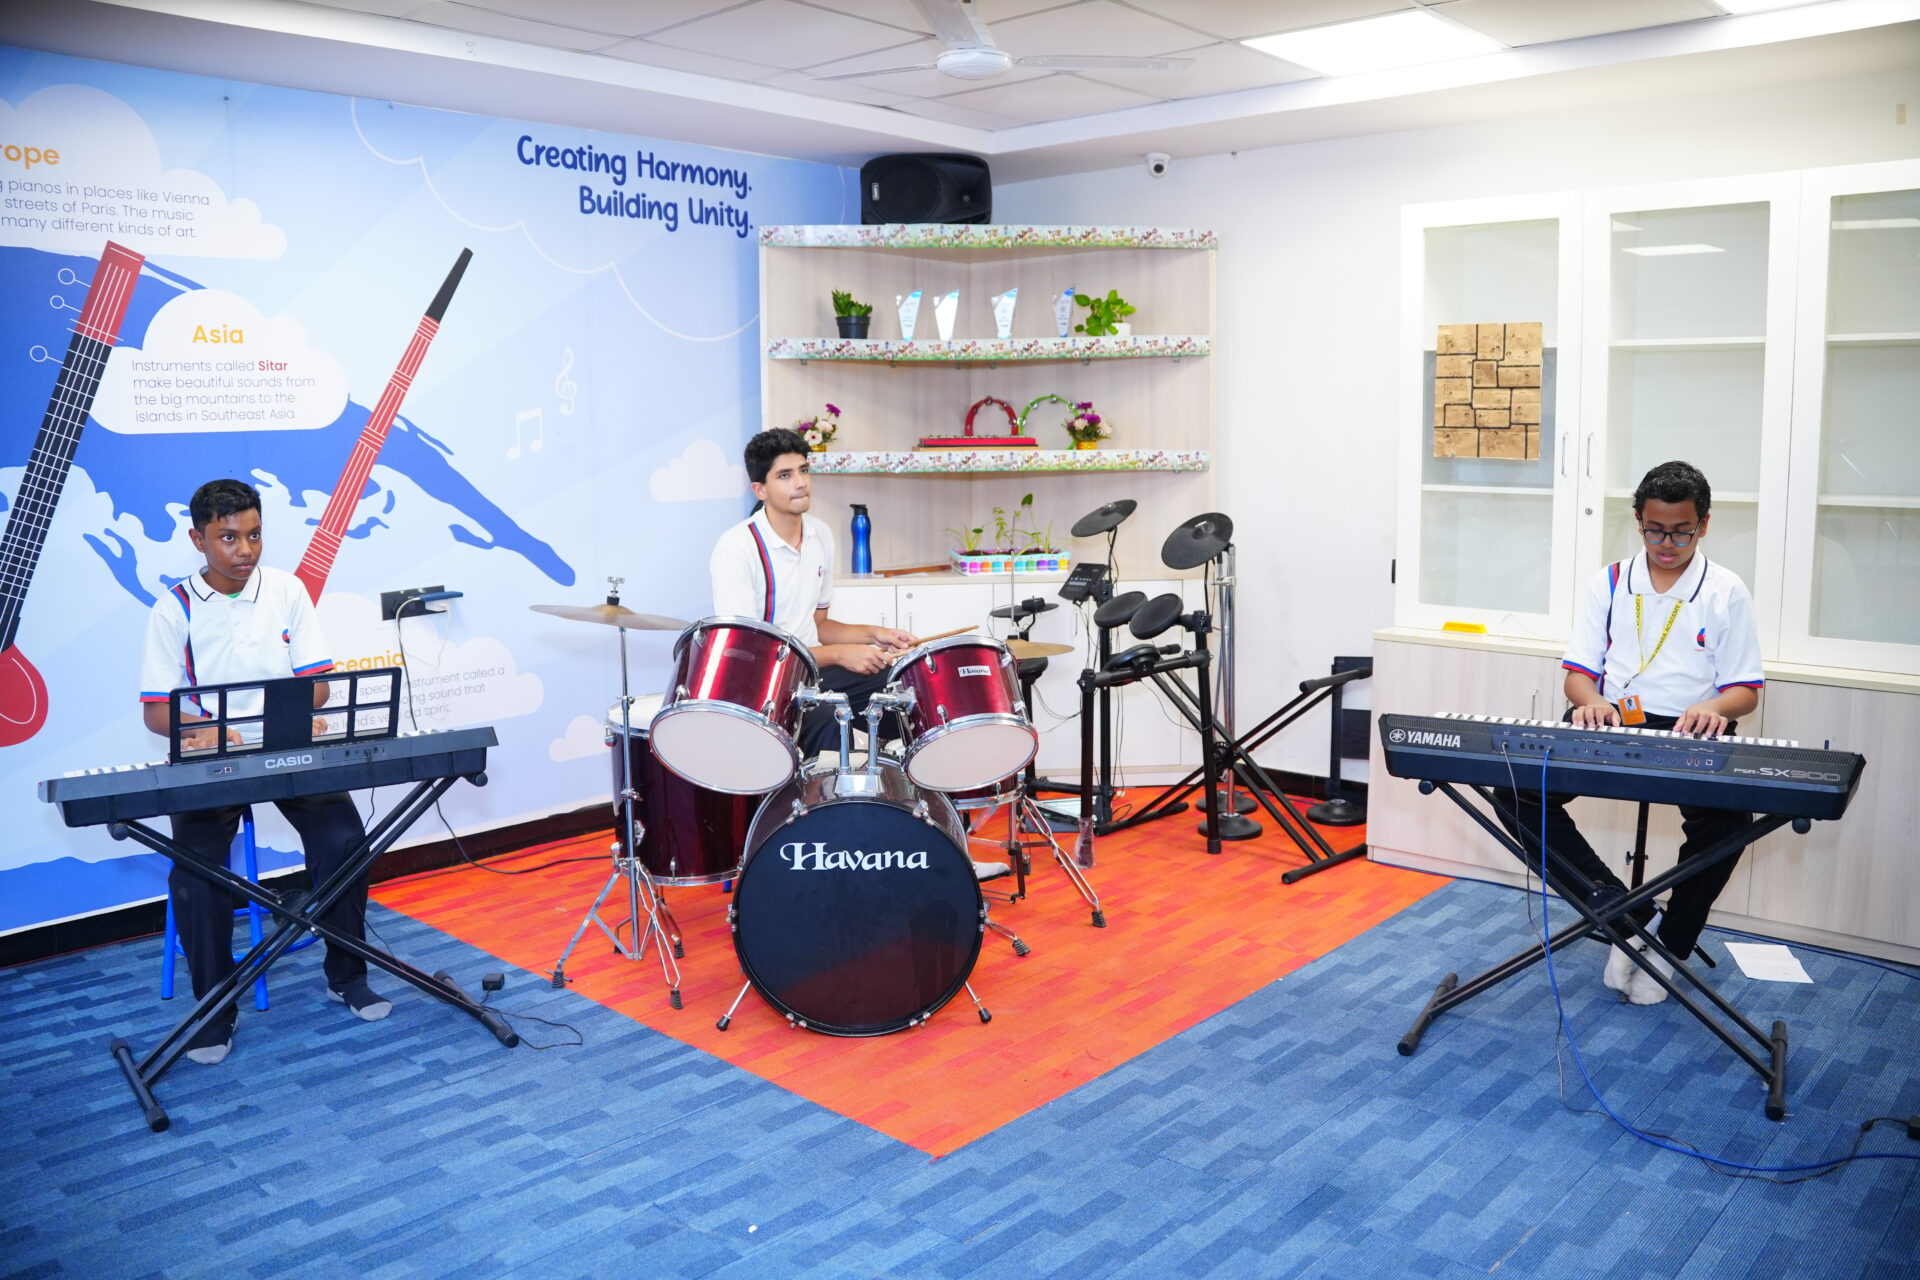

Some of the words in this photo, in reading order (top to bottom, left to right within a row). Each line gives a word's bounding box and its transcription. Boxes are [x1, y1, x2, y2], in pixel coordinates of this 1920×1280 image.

[517, 135, 627, 186] Creating
[637, 150, 752, 200] Harmony.
[8, 178, 62, 195] pianos
[66, 182, 79, 195] in
[83, 184, 133, 200] places
[137, 188, 158, 202] like
[162, 191, 210, 206] Vienna
[4, 198, 58, 212] streets
[62, 200, 77, 213] of
[81, 201, 119, 216] Paris.
[121, 204, 148, 218] The
[152, 208, 194, 221] music
[579, 185, 678, 232] Building
[688, 196, 754, 239] Unity.
[1, 216, 47, 233] many
[51, 218, 114, 234] different
[118, 221, 154, 236] kinds
[158, 224, 171, 237] of
[175, 226, 197, 238] art.
[191, 323, 244, 344] Asia
[131, 360, 212, 373] Instruments
[215, 360, 255, 372] called
[258, 359, 288, 372] Sitar
[133, 377, 171, 389] make
[175, 377, 234, 389] beautiful
[237, 376, 283, 388] sounds
[286, 376, 315, 388] from
[134, 394, 157, 406] the
[160, 394, 182, 408] big
[186, 393, 256, 405] mountains
[259, 393, 271, 404] to
[275, 392, 296, 404] the
[135, 410, 183, 423] islands
[186, 410, 197, 422] in
[201, 409, 266, 421] Southeast
[333, 649, 405, 673] ceania
[402, 672, 461, 689] instrument
[463, 664, 495, 681] called
[497, 666, 505, 676] a
[428, 686, 462, 700] sound
[464, 683, 486, 695] that
[1407, 730, 1461, 748] YAMAHA
[264, 754, 313, 769] CASIO
[779, 842, 930, 871] Havana
